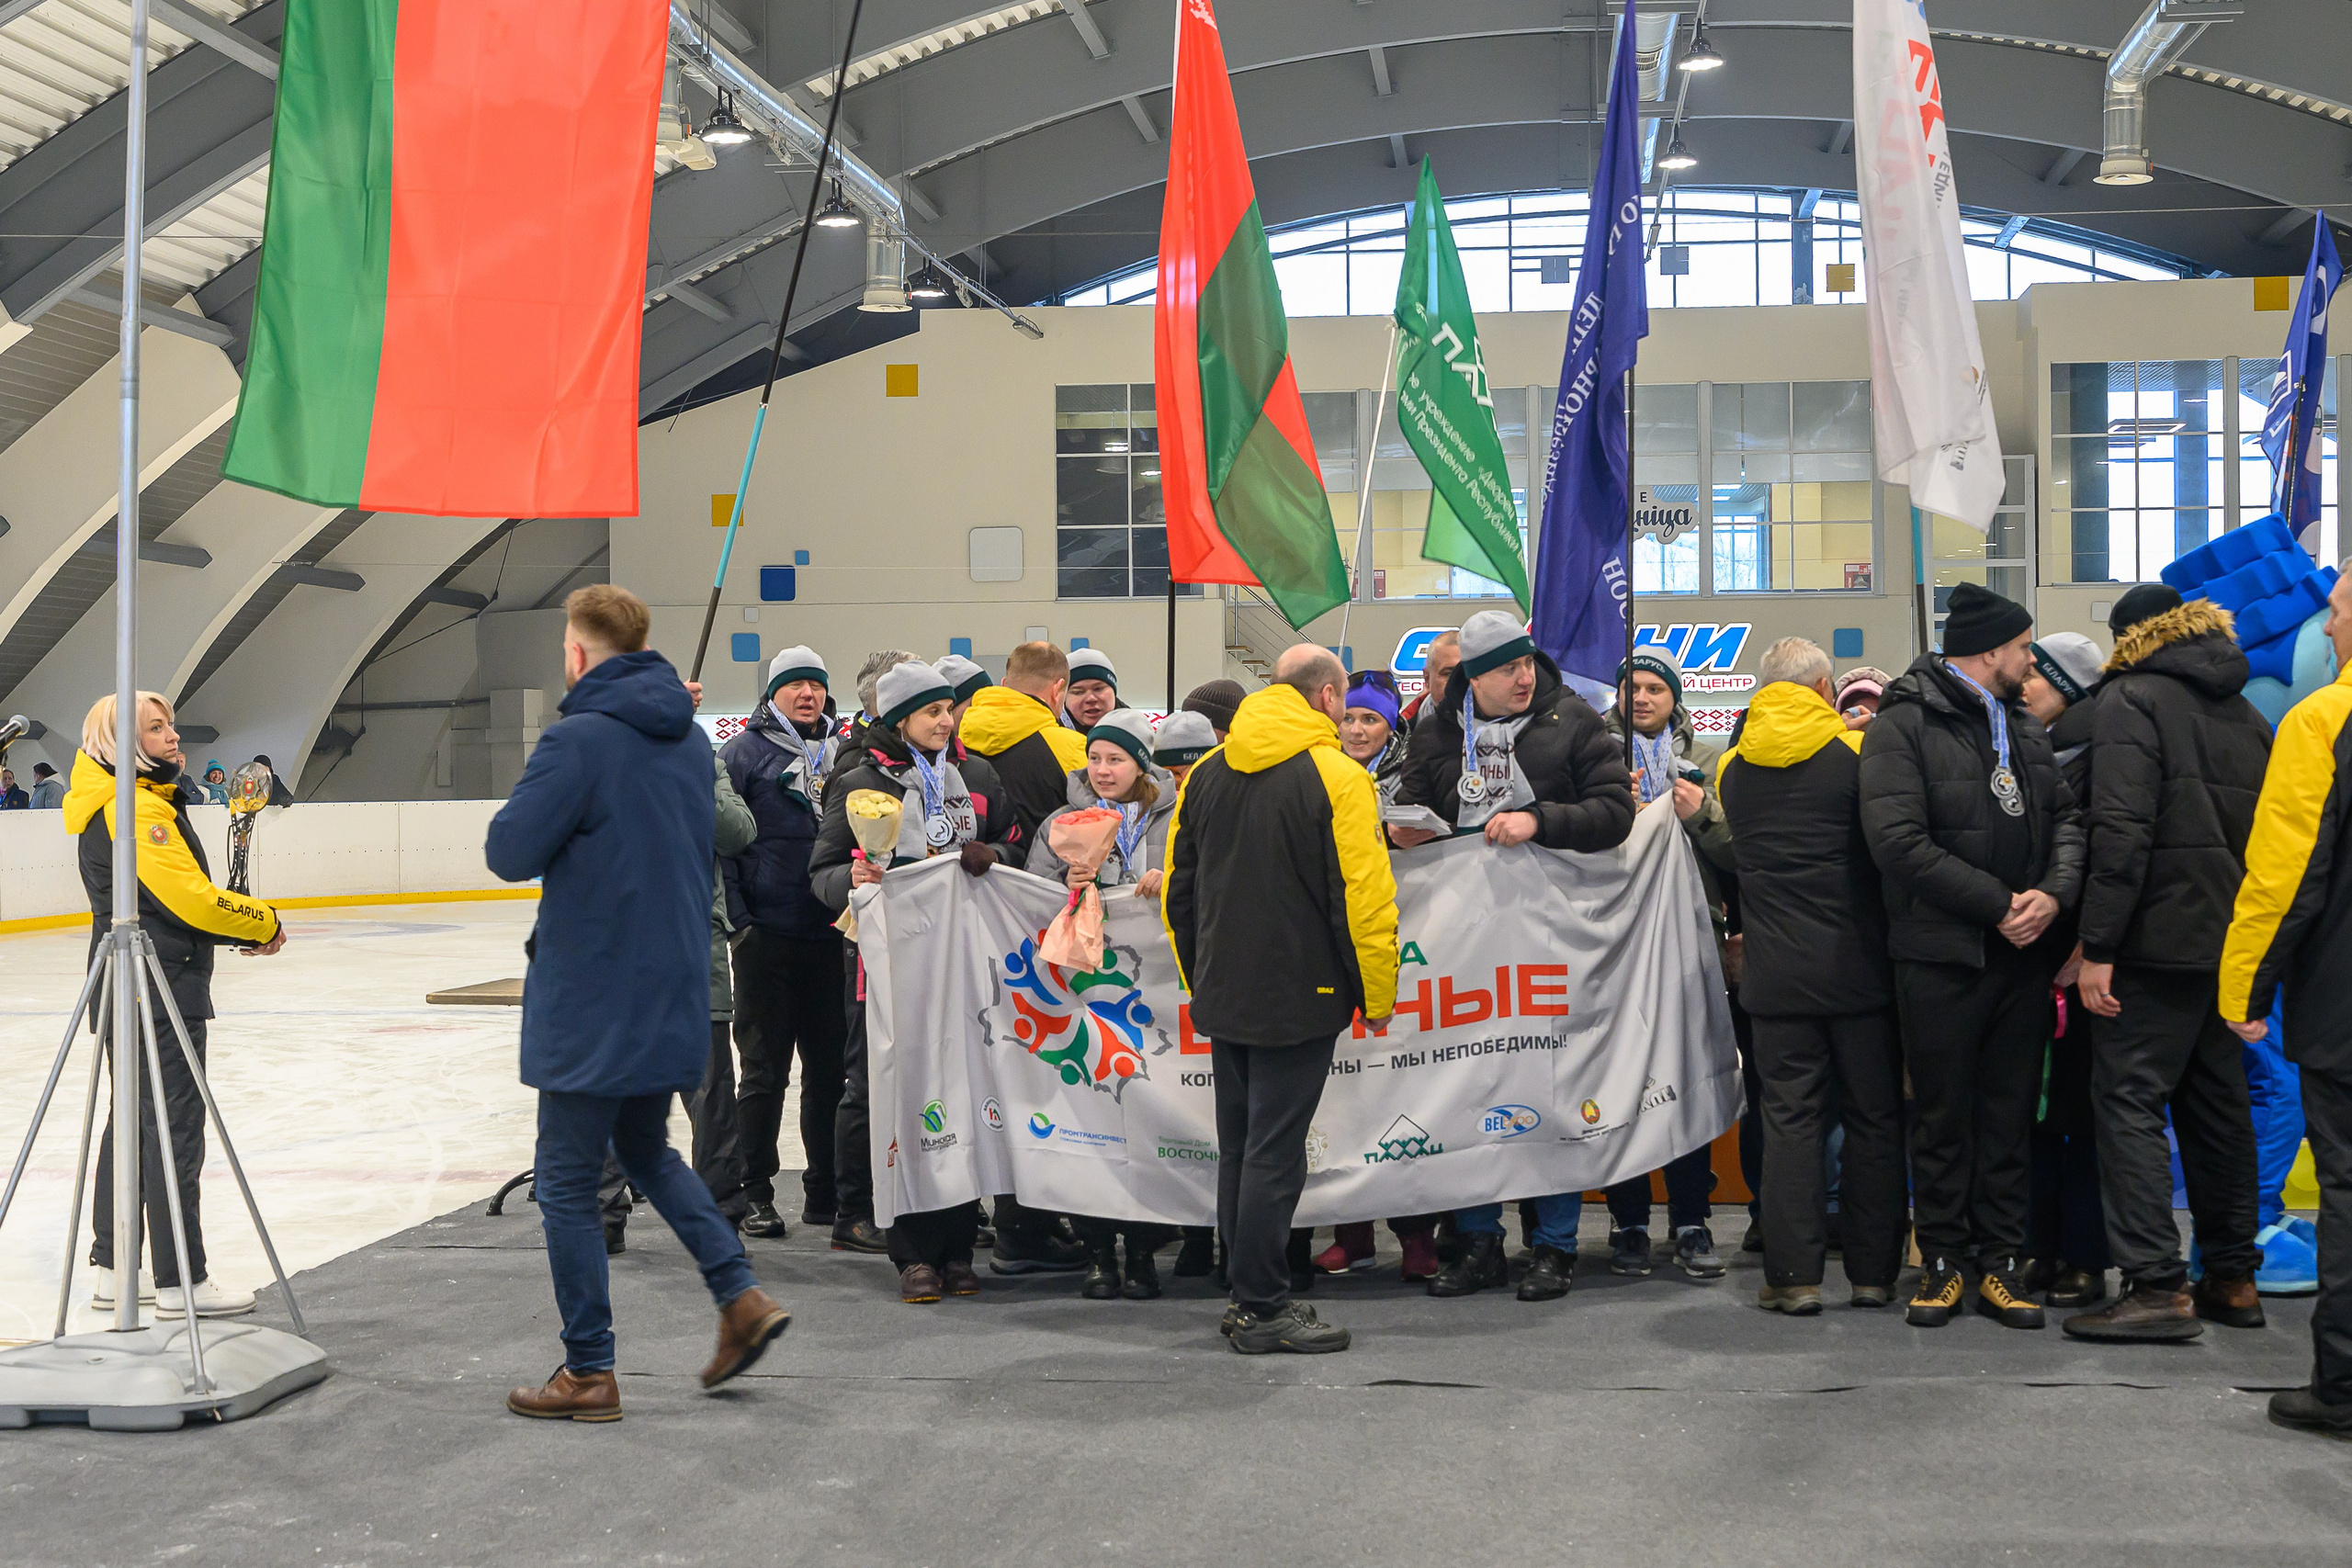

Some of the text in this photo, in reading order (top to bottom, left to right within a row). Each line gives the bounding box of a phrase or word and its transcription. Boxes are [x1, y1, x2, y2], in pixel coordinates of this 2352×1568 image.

[1700, 678, 1753, 690] ЦЕНТР
[217, 897, 264, 921] BELARUS
[1391, 1052, 1425, 1069] МЫ
[1432, 1034, 1567, 1063] НЕПОБЕДИМЫ!
